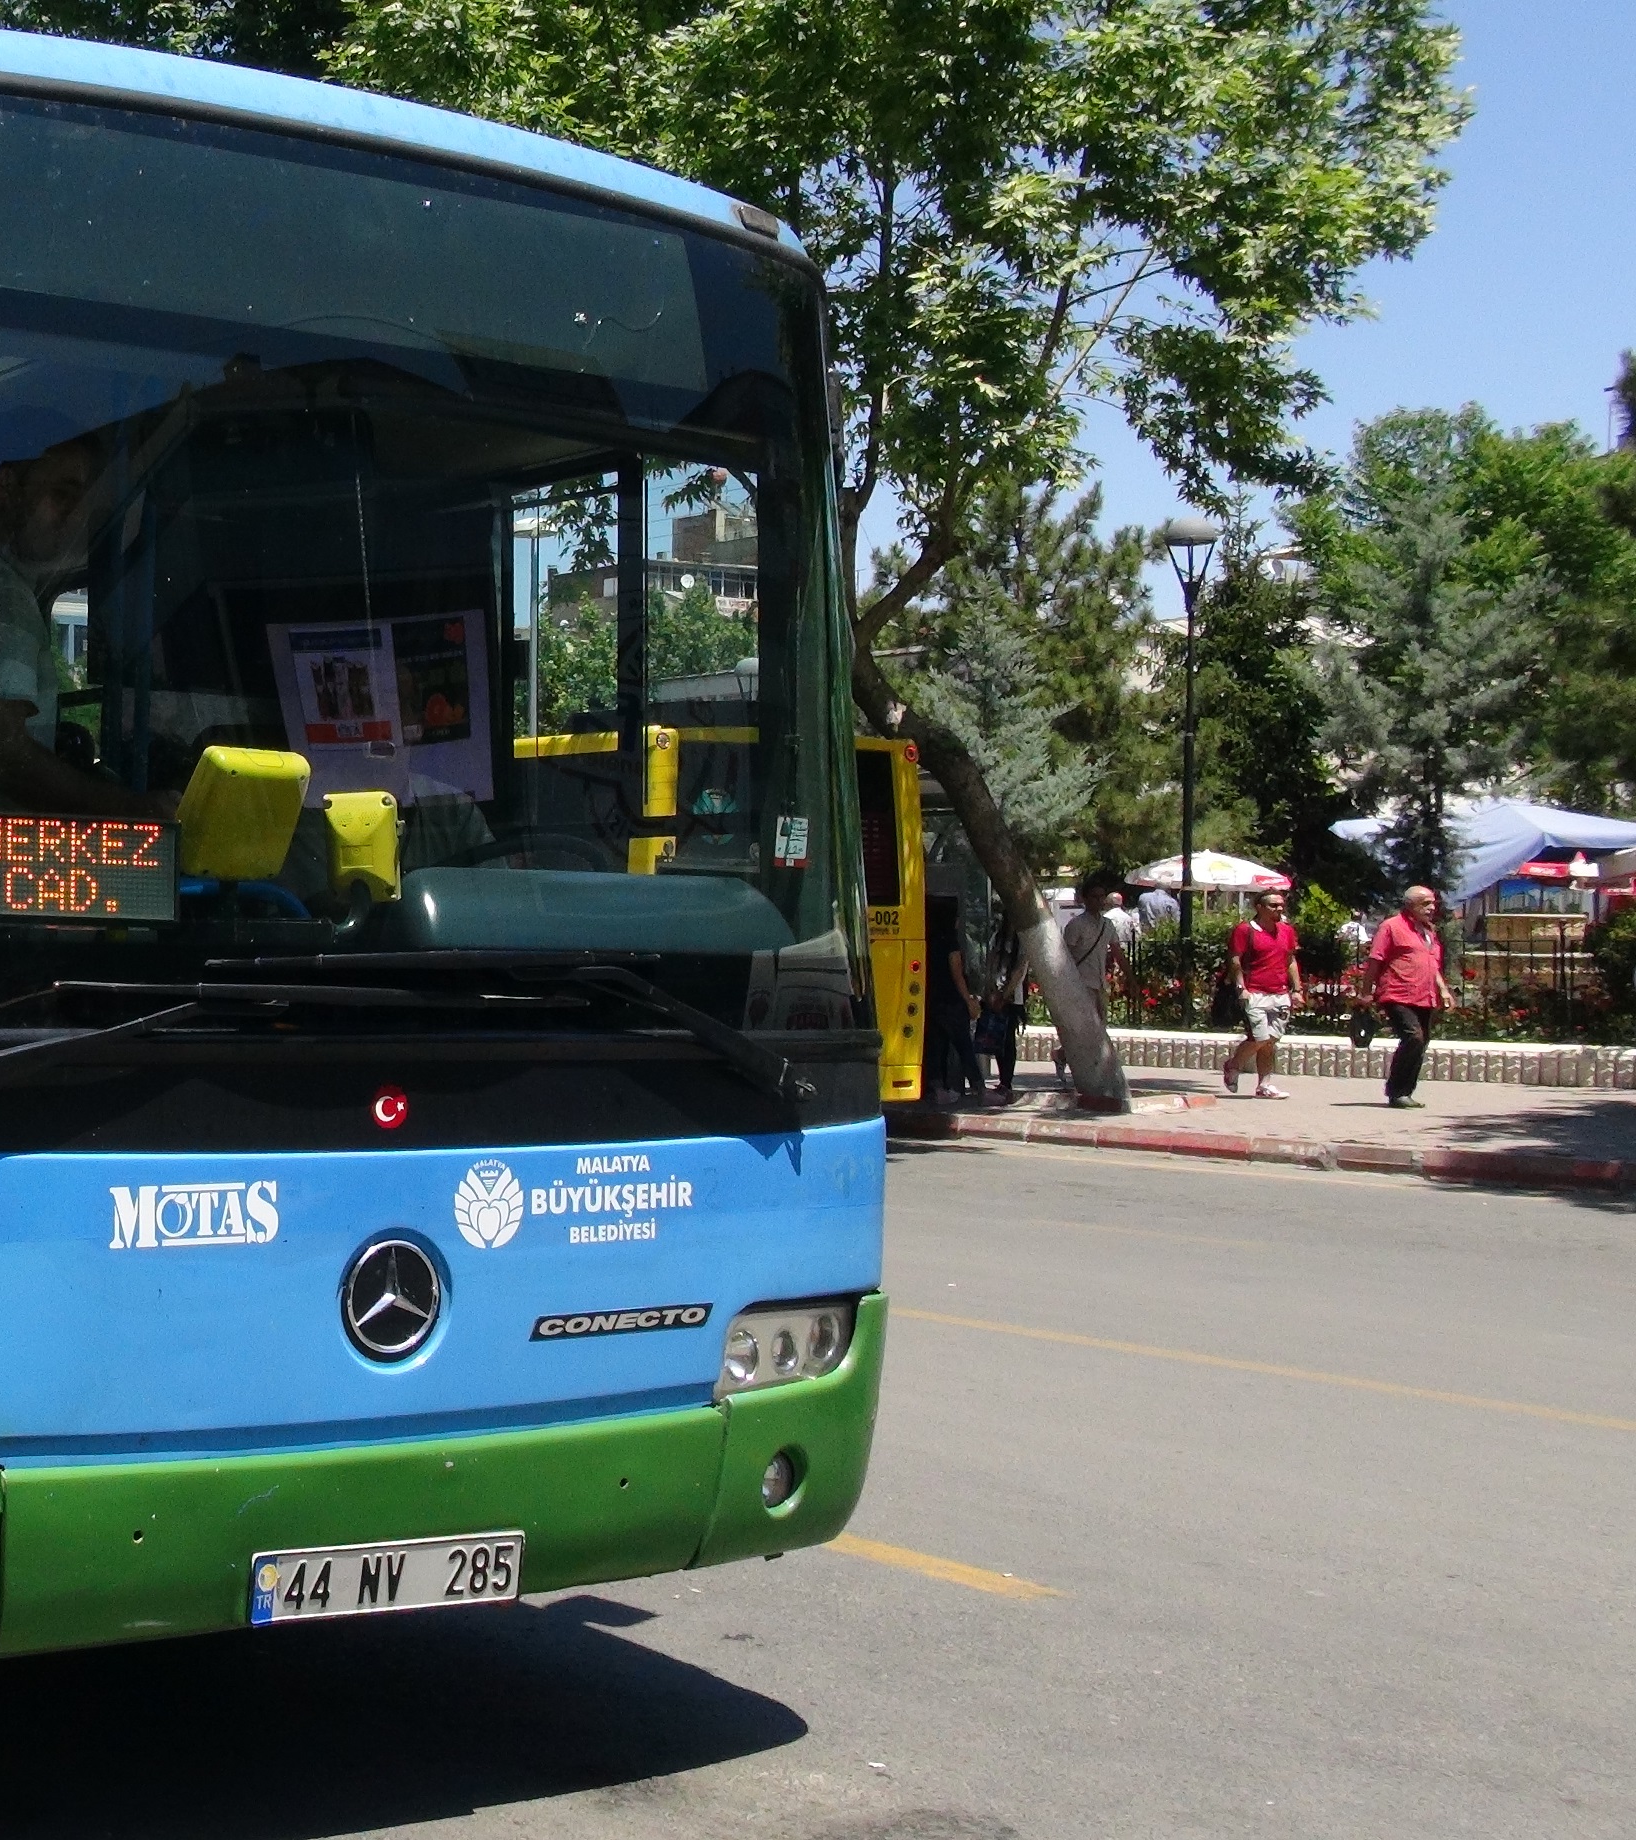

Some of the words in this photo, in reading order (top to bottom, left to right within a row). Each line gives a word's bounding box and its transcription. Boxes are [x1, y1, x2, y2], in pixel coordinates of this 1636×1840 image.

[5, 866, 118, 912] CAD.
[576, 1154, 651, 1175] MALATYA
[530, 1174, 693, 1218] BÜYÜKŞEHİR
[569, 1217, 656, 1244] BELEDİYESİ
[538, 1307, 706, 1337] CONECTO
[284, 1558, 333, 1610] 44
[358, 1552, 407, 1604] NV
[444, 1544, 515, 1596] 285
[257, 1594, 272, 1610] TR
